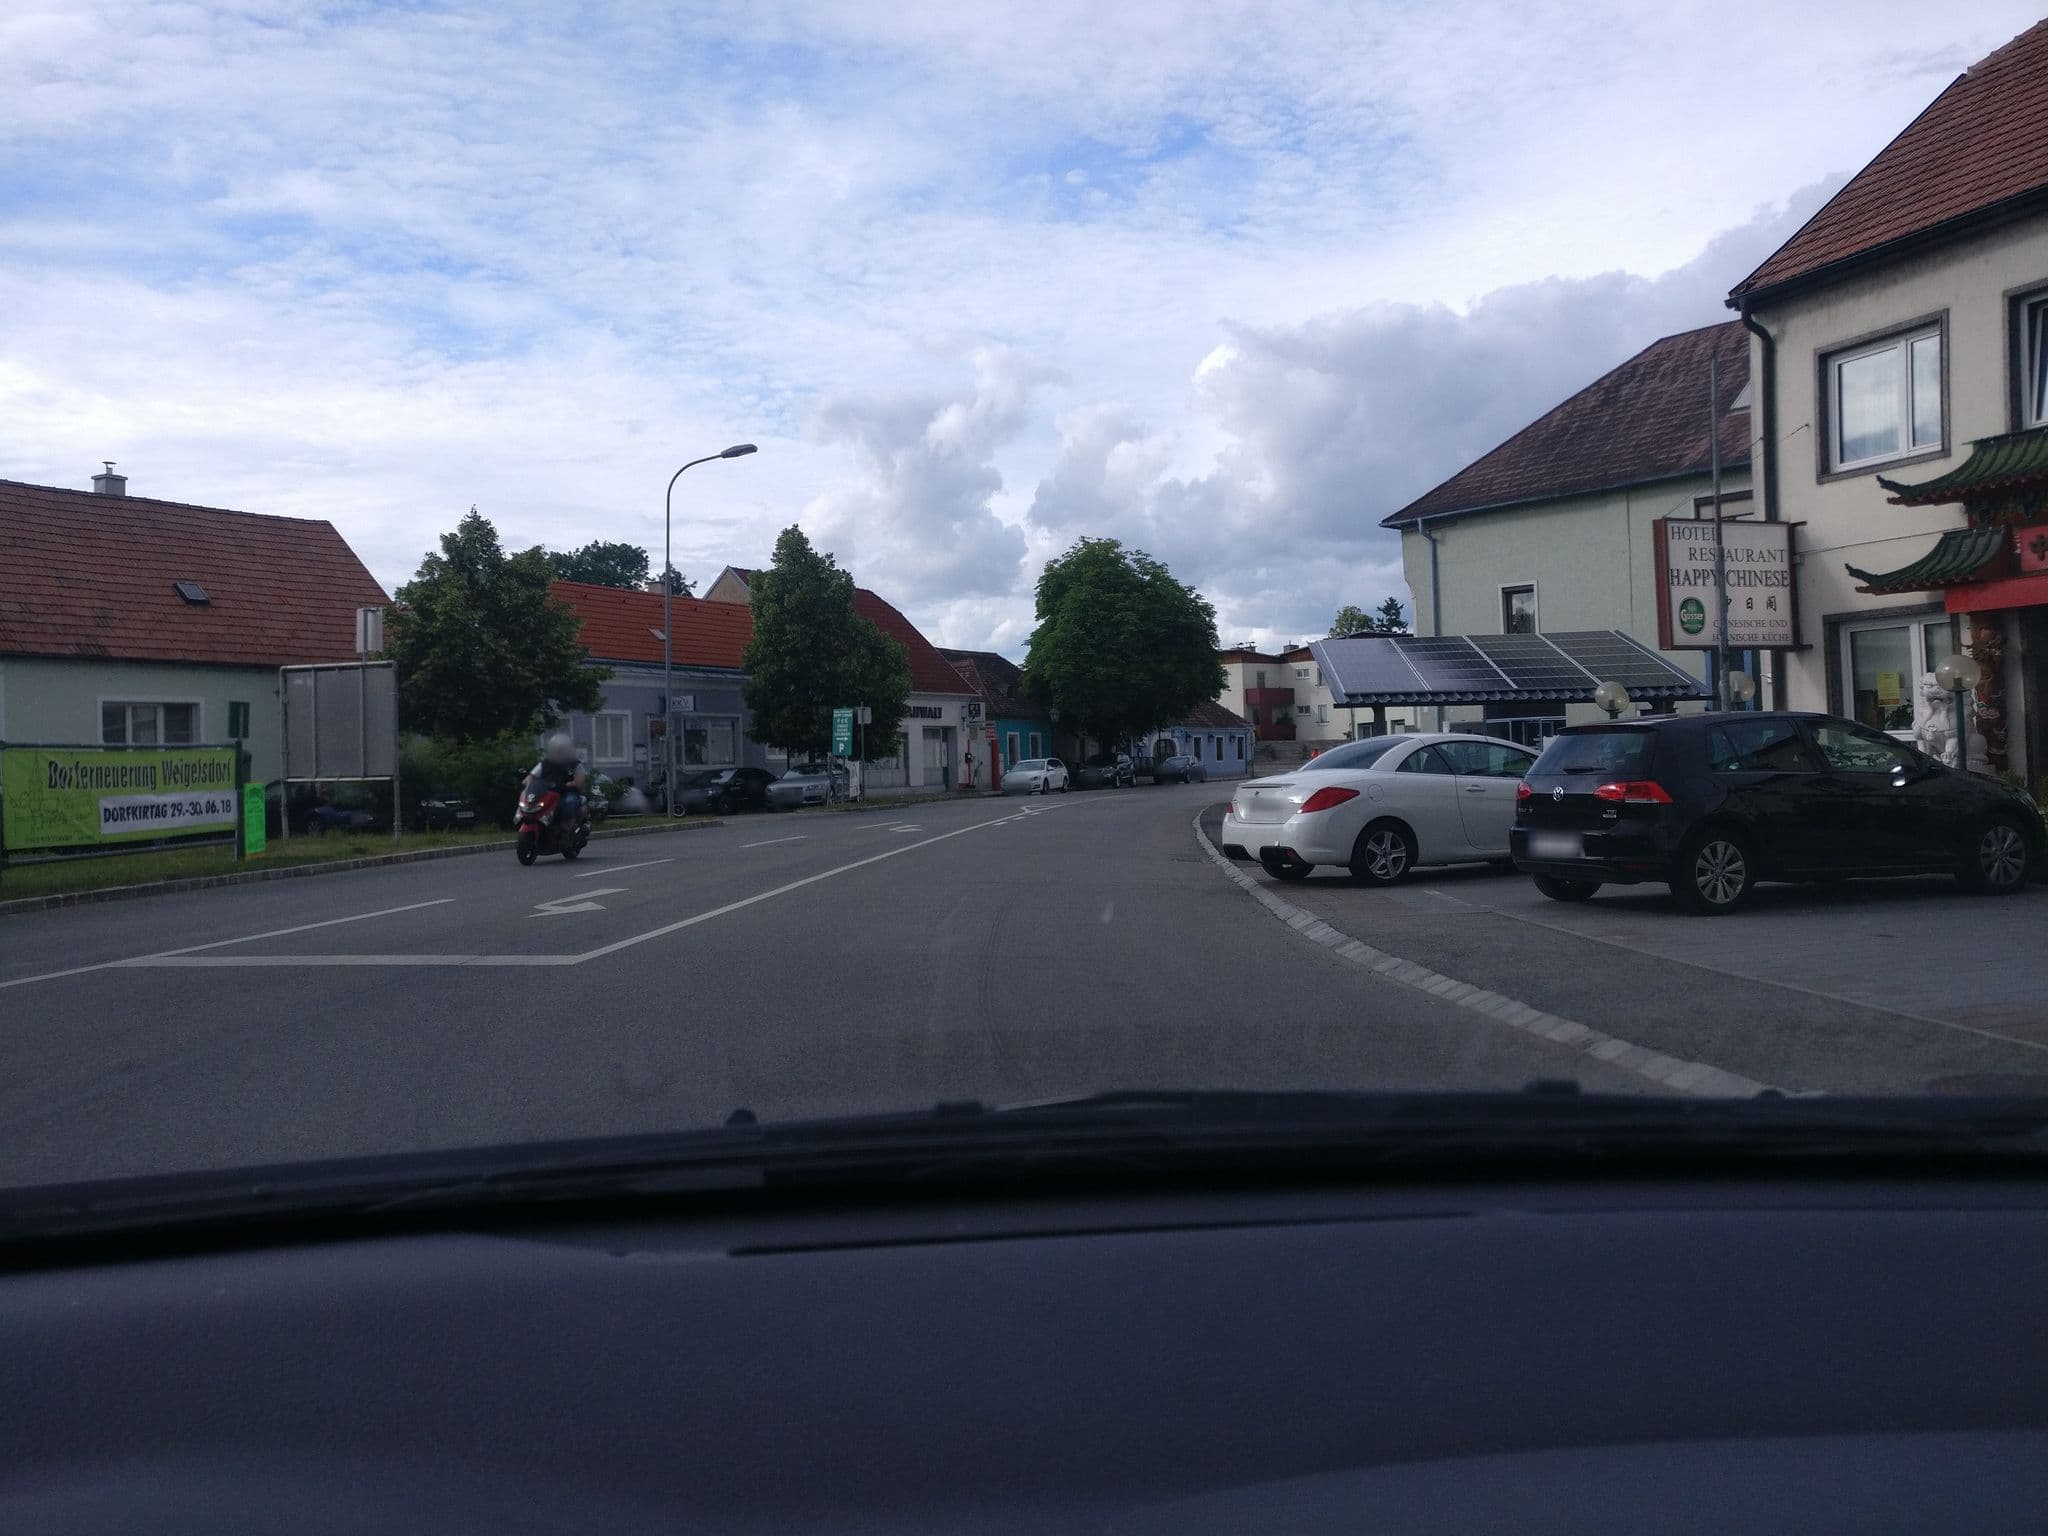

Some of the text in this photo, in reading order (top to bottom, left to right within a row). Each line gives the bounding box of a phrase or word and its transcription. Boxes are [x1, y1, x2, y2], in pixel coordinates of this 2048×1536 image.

[1689, 547, 1785, 563] RESAURANT
[1726, 570, 1790, 587] CHINESE
[1769, 620, 1787, 628] UND
[162, 757, 232, 787] Weigelsdorf
[103, 803, 168, 824] DORFKIRTAG
